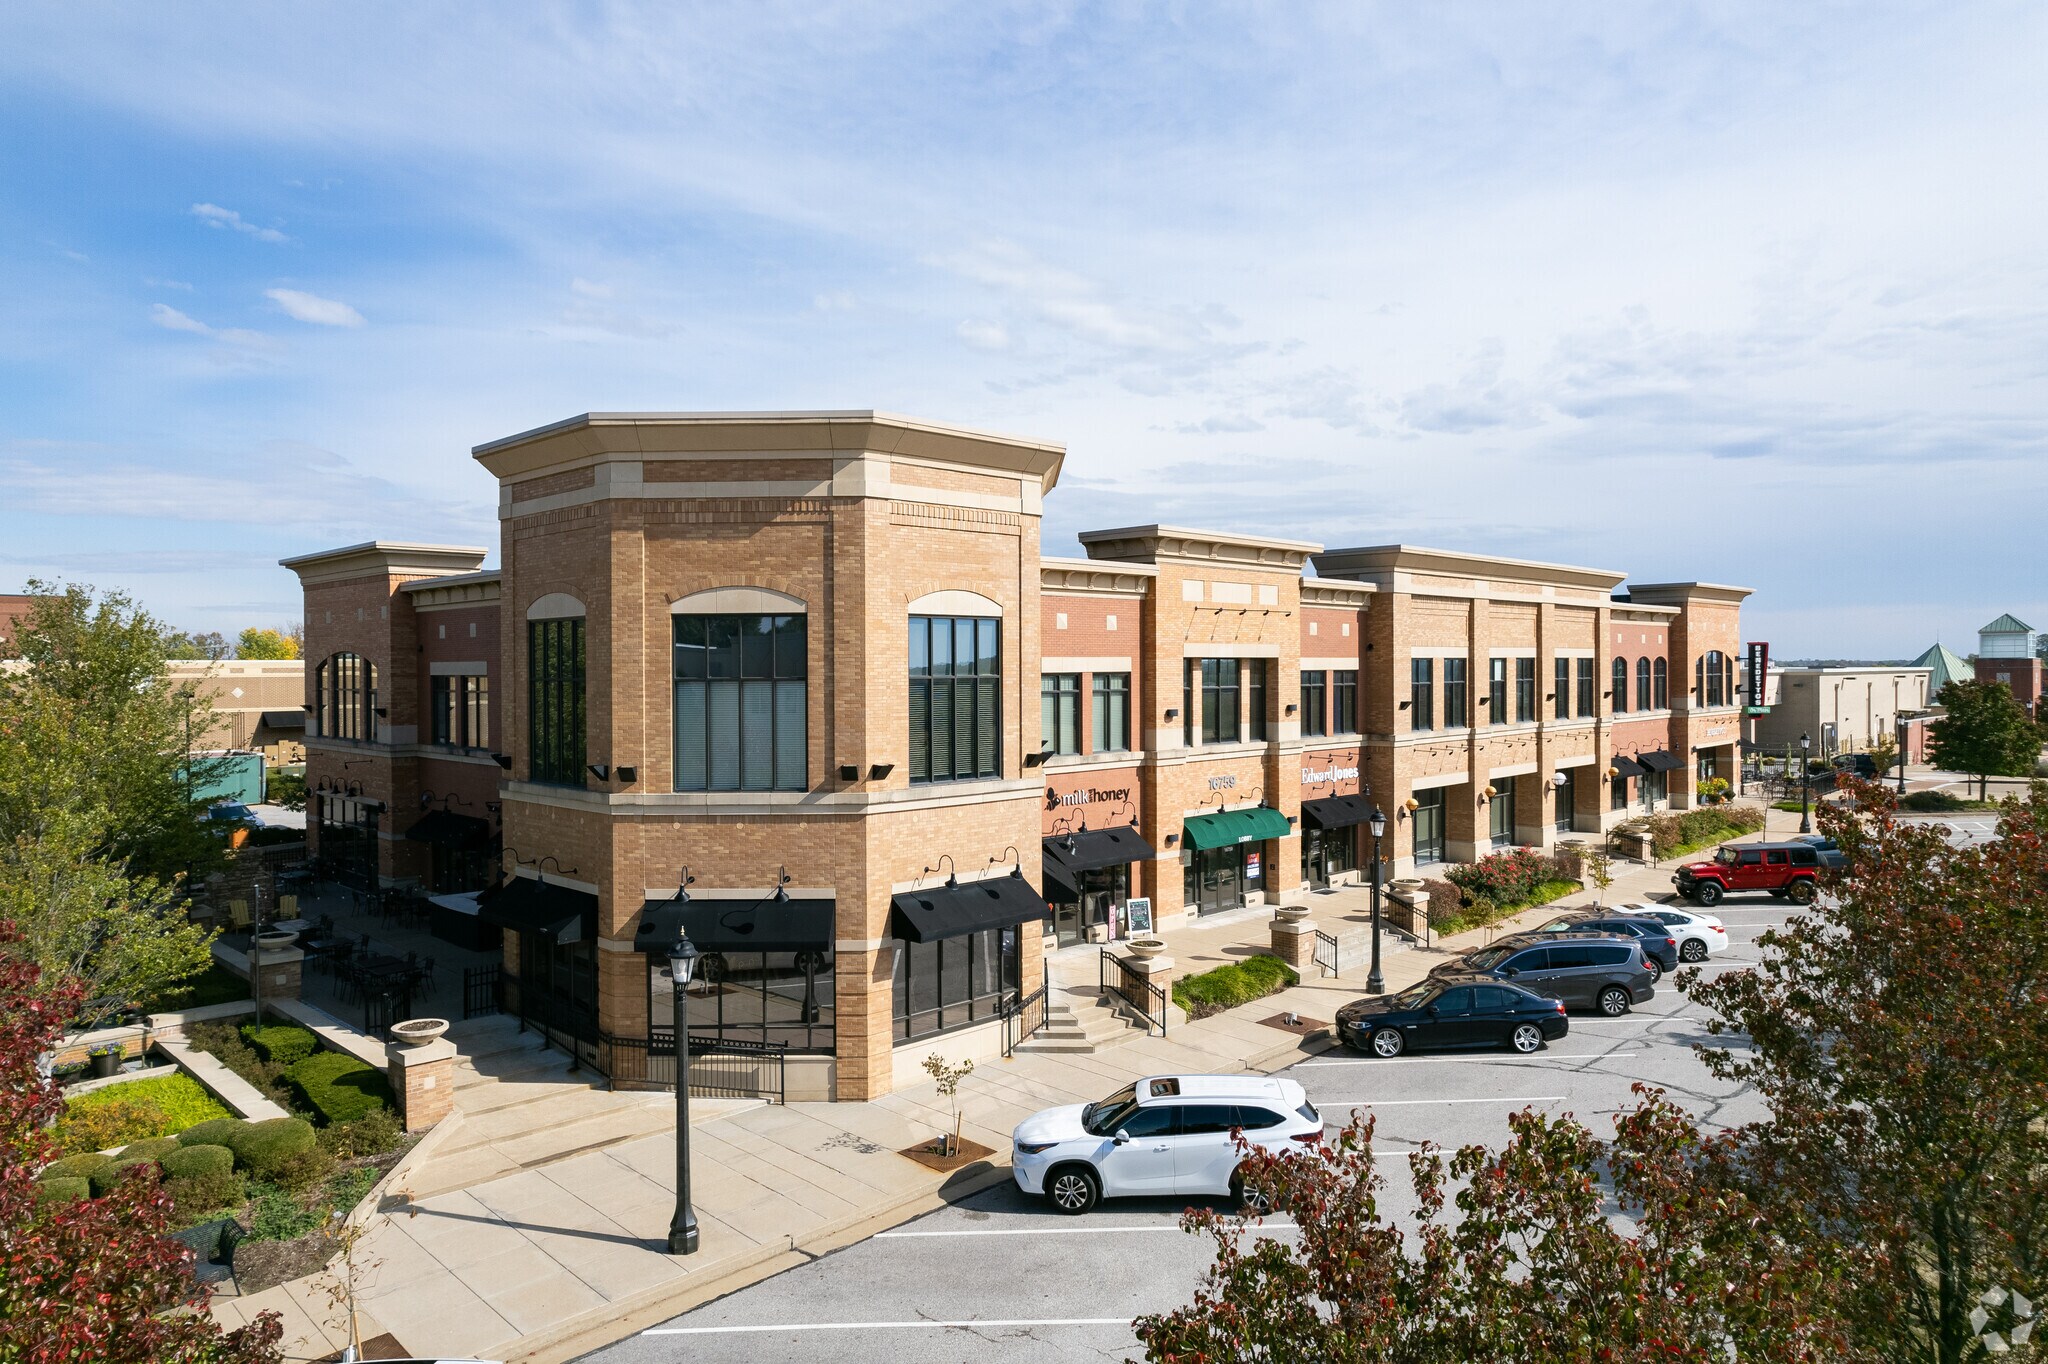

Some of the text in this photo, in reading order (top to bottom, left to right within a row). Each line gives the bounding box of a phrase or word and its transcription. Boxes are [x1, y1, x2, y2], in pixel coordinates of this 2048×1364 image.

[1208, 775, 1236, 790] 16759
[1301, 765, 1359, 784] Edward Jones
[1061, 789, 1089, 806] milk
[1093, 788, 1130, 803] honey
